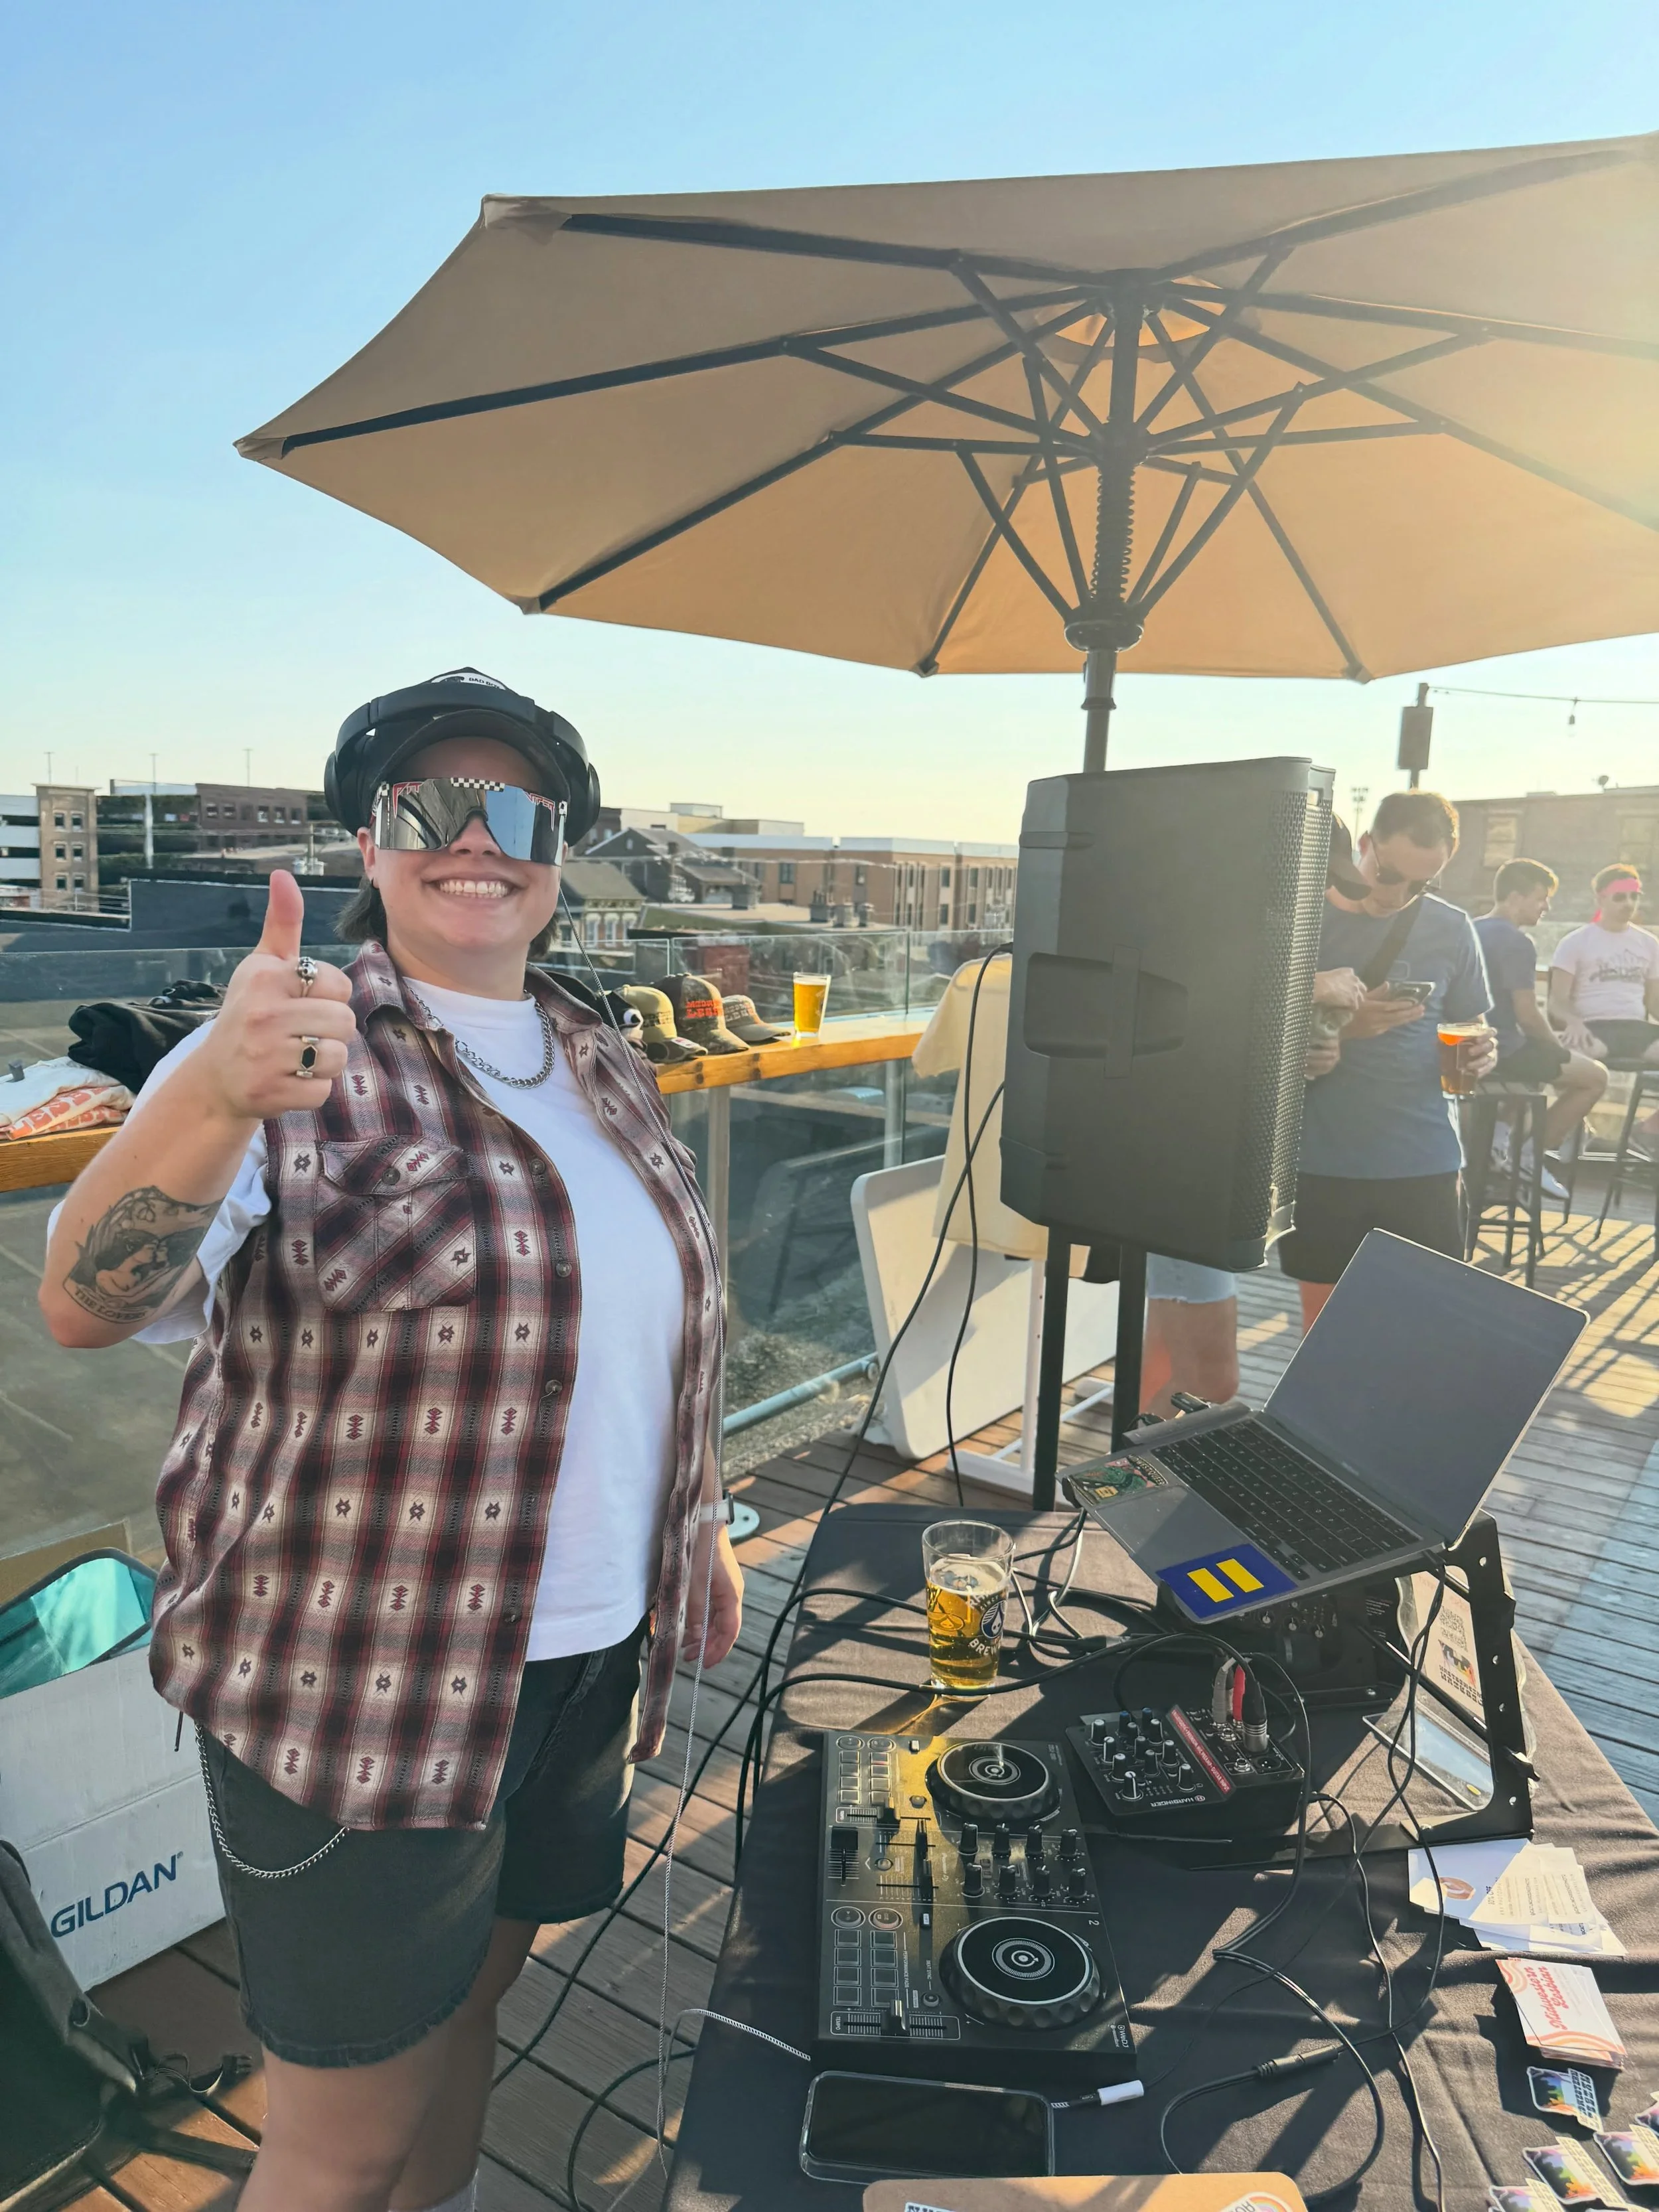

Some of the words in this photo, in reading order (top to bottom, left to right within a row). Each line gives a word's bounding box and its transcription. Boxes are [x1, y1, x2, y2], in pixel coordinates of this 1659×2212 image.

[51, 1855, 179, 1938] GILDAN
[1524, 1966, 1568, 2030] Midwestern
[1538, 1966, 1569, 2009] Lesbian
